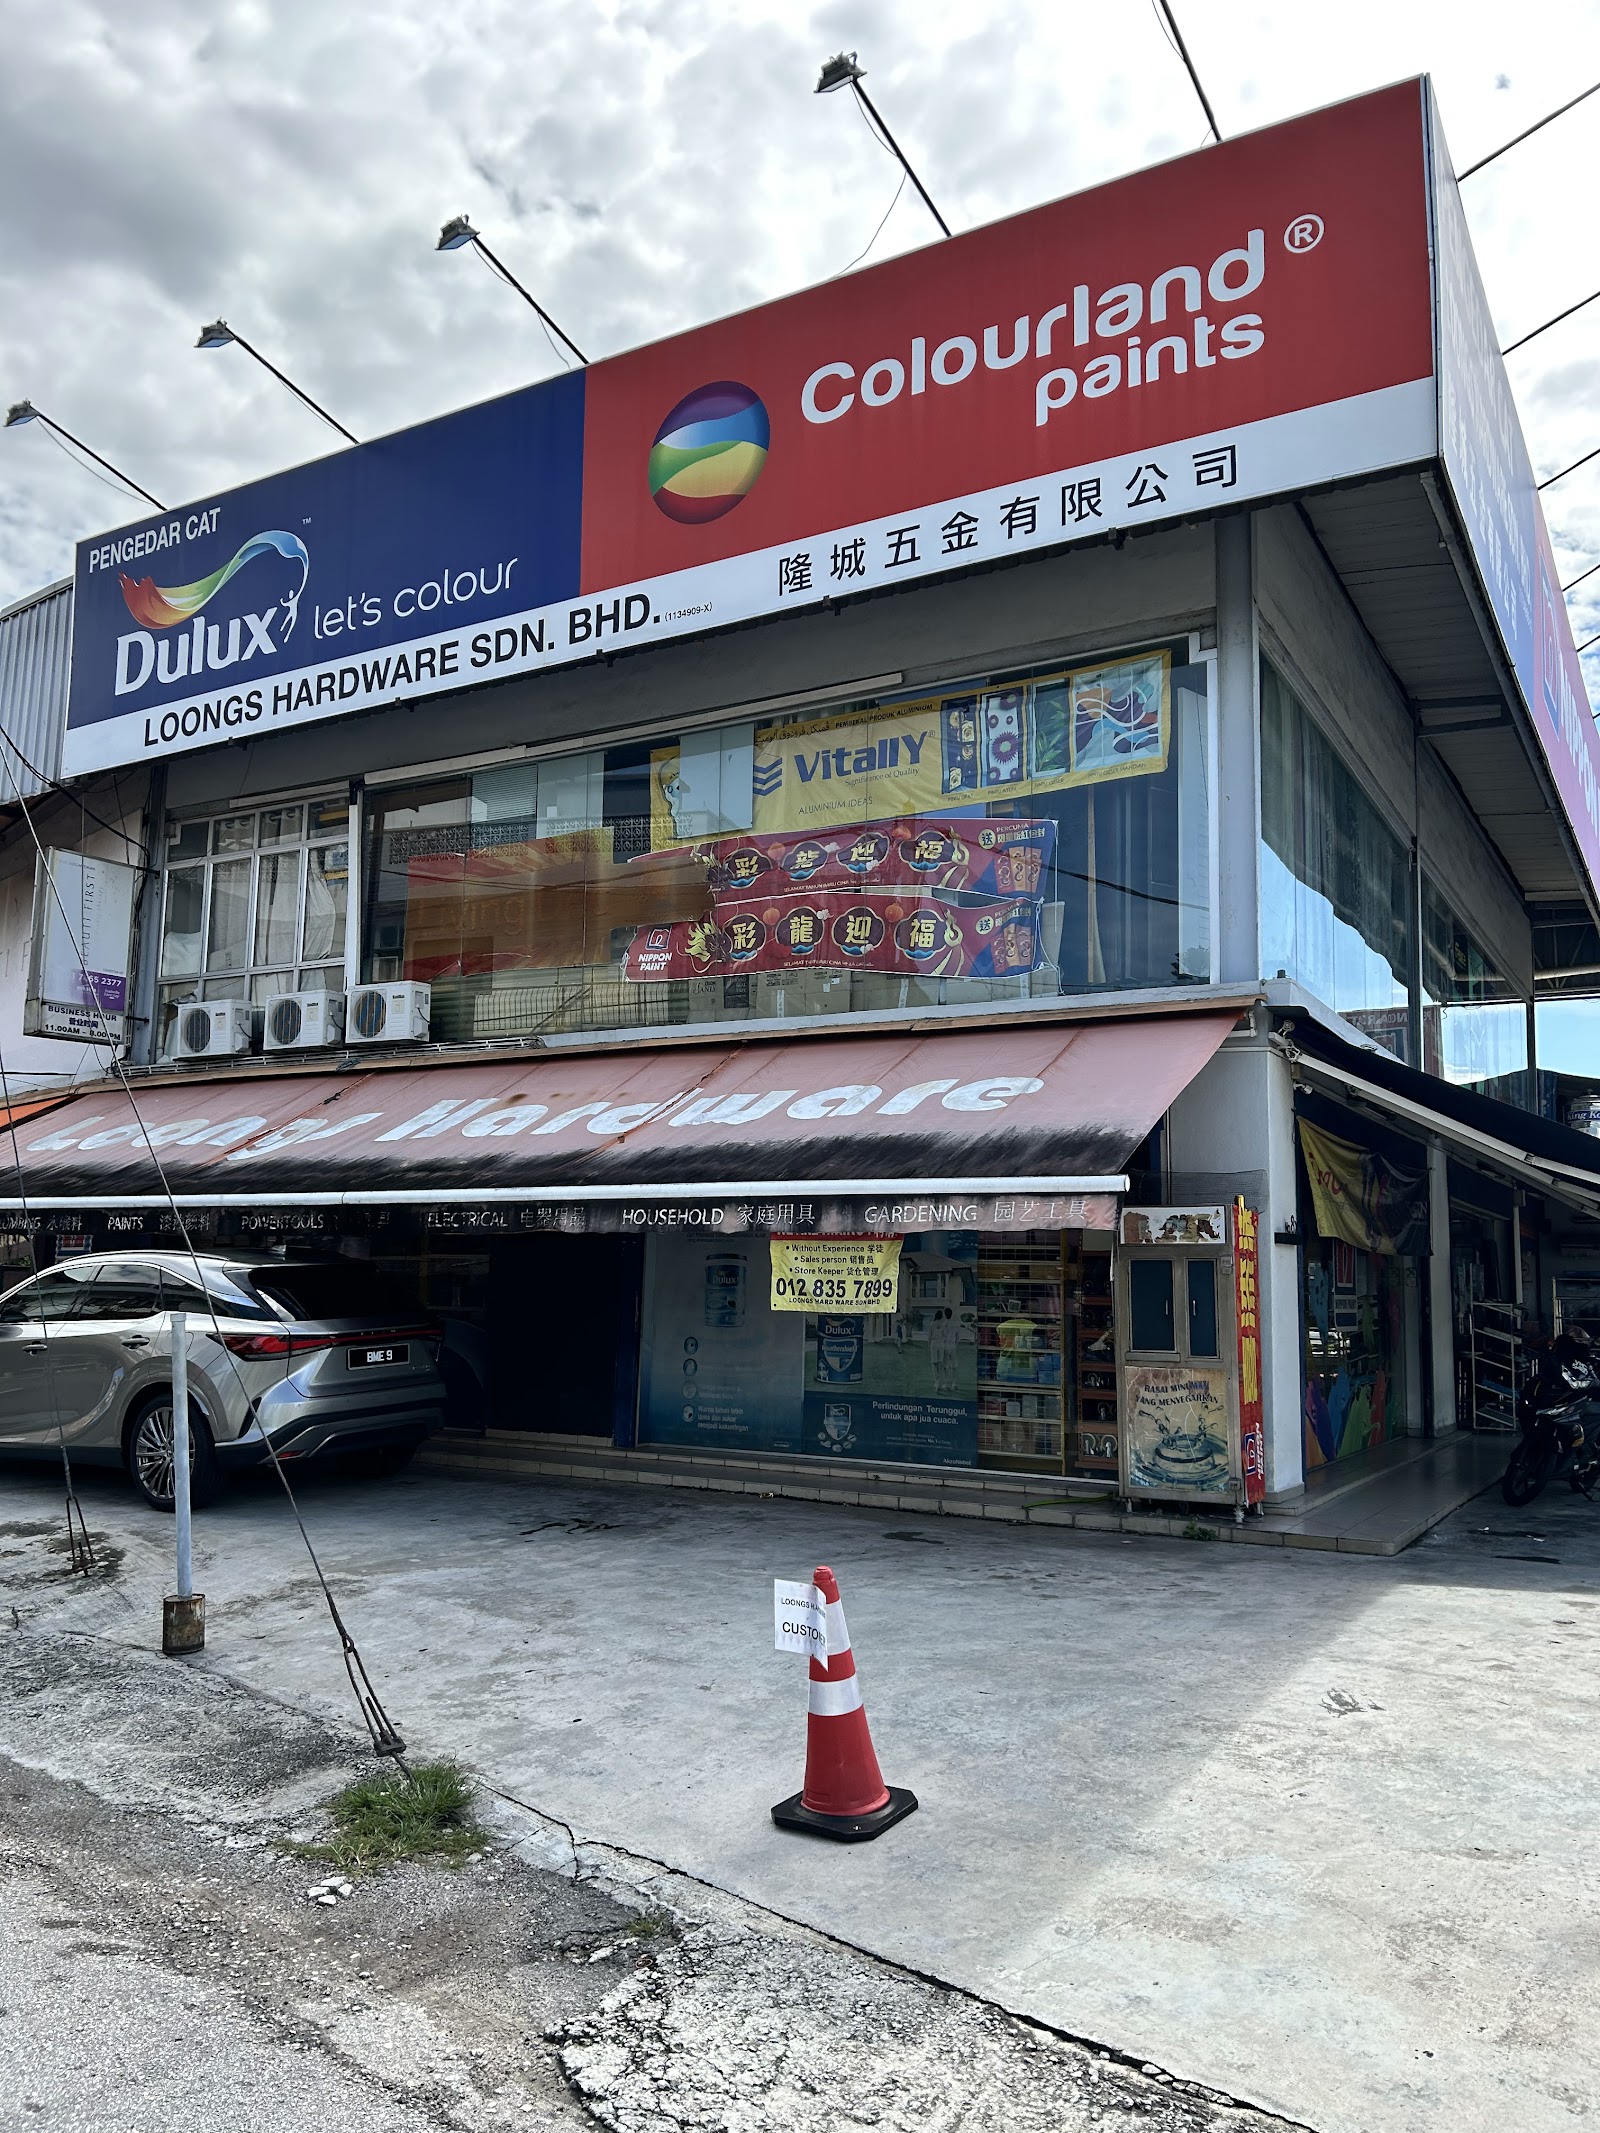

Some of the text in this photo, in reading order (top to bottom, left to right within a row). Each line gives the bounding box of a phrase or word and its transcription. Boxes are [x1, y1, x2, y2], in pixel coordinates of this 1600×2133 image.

[800, 228, 1265, 424] Colourland
[1034, 313, 1265, 426] paints
[778, 443, 1239, 597] 隆城五金有限公司
[89, 507, 221, 573] PENGEDAR CAT
[314, 558, 519, 640] let's colour
[114, 606, 278, 696] Dulux
[143, 593, 713, 747] LOONGS HARDWARE SDN. BHD. (1134909-X)
[835, 703, 933, 729] PEMBEKAL PRODUK ALUMINIUM
[1559, 650, 1598, 838] NIPPON
[893, 767, 920, 780] Quality
[798, 796, 873, 815] ALUMINIUM IDEAS
[996, 823, 1030, 832] PERCUMA
[84, 872, 96, 911] FIRST
[733, 914, 937, 949] 彩龍迎福
[638, 952, 672, 962] NIPPON
[639, 961, 667, 971] PAINT
[101, 978, 122, 987] 2377
[48, 1005, 118, 1022] BUSINESS HOUR
[373, 1076, 1045, 1142] Hardware
[427, 1211, 508, 1228] ELECTRICAL
[521, 1207, 586, 1228] 电器用品
[622, 1207, 724, 1225] HOUSEHOLD
[737, 1204, 816, 1225] 家庭用具
[864, 1204, 978, 1224] GARDENING
[993, 1200, 1087, 1223] 园艺工具
[107, 1216, 144, 1231] PAINTS
[241, 1213, 324, 1230] POWERTOOLS
[792, 1244, 820, 1252] Without
[823, 1245, 864, 1254] Experience
[801, 1255, 820, 1263] Sales
[821, 1256, 847, 1264] person
[795, 1266, 816, 1274] Store
[818, 1267, 844, 1276] Keeper
[776, 1278, 893, 1298] 012 835 7899
[826, 1324, 851, 1335] Dulux
[1144, 1384, 1168, 1393] RASAI
[872, 1401, 968, 1416] Perlindungan Terunggul,
[1136, 1394, 1156, 1405] YANG
[881, 1413, 959, 1425] untuk apa jua cuaca.
[781, 1597, 810, 1609] LOONGS
